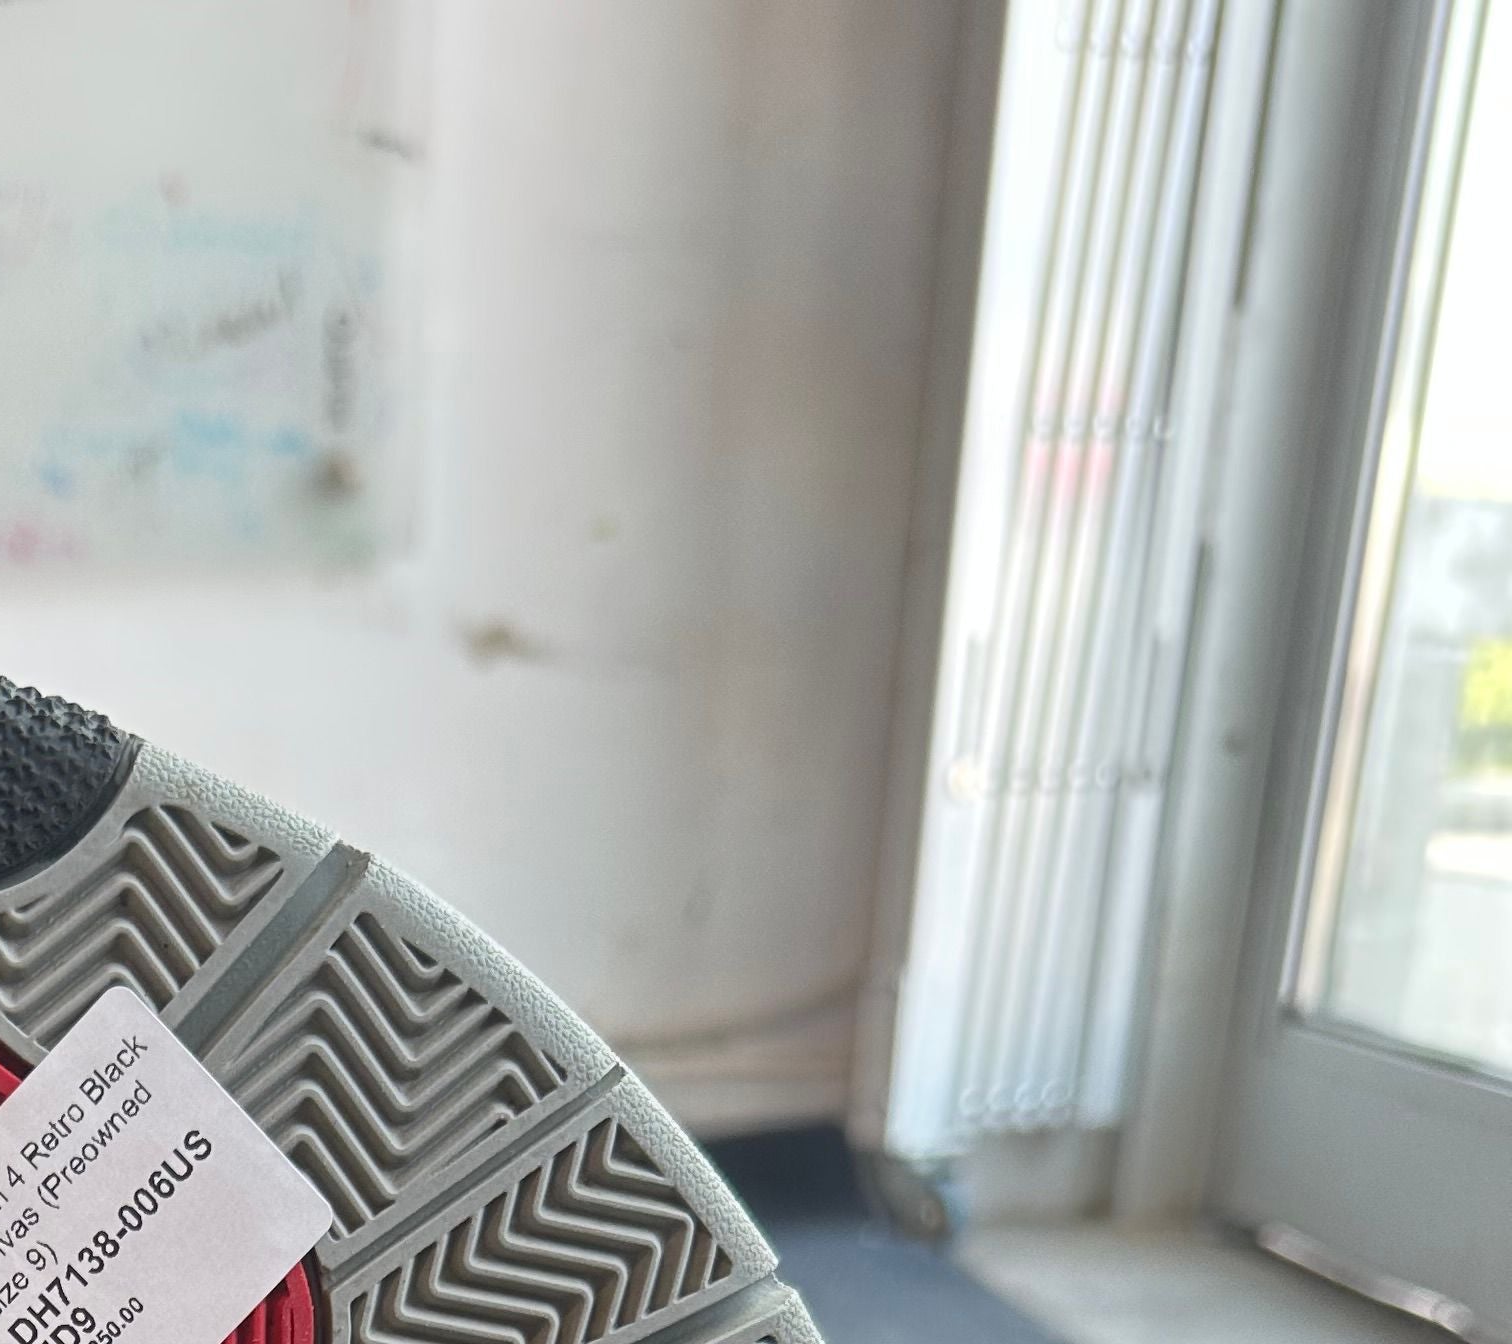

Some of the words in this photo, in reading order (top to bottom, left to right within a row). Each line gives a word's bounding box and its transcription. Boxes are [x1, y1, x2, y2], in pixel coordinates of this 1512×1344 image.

[6, 1164, 26, 1189] 4
[19, 1103, 86, 1171] Retro
[78, 1035, 149, 1107] Black
[37, 1079, 153, 1211] (Preowned
[25, 1241, 60, 1273] 9)
